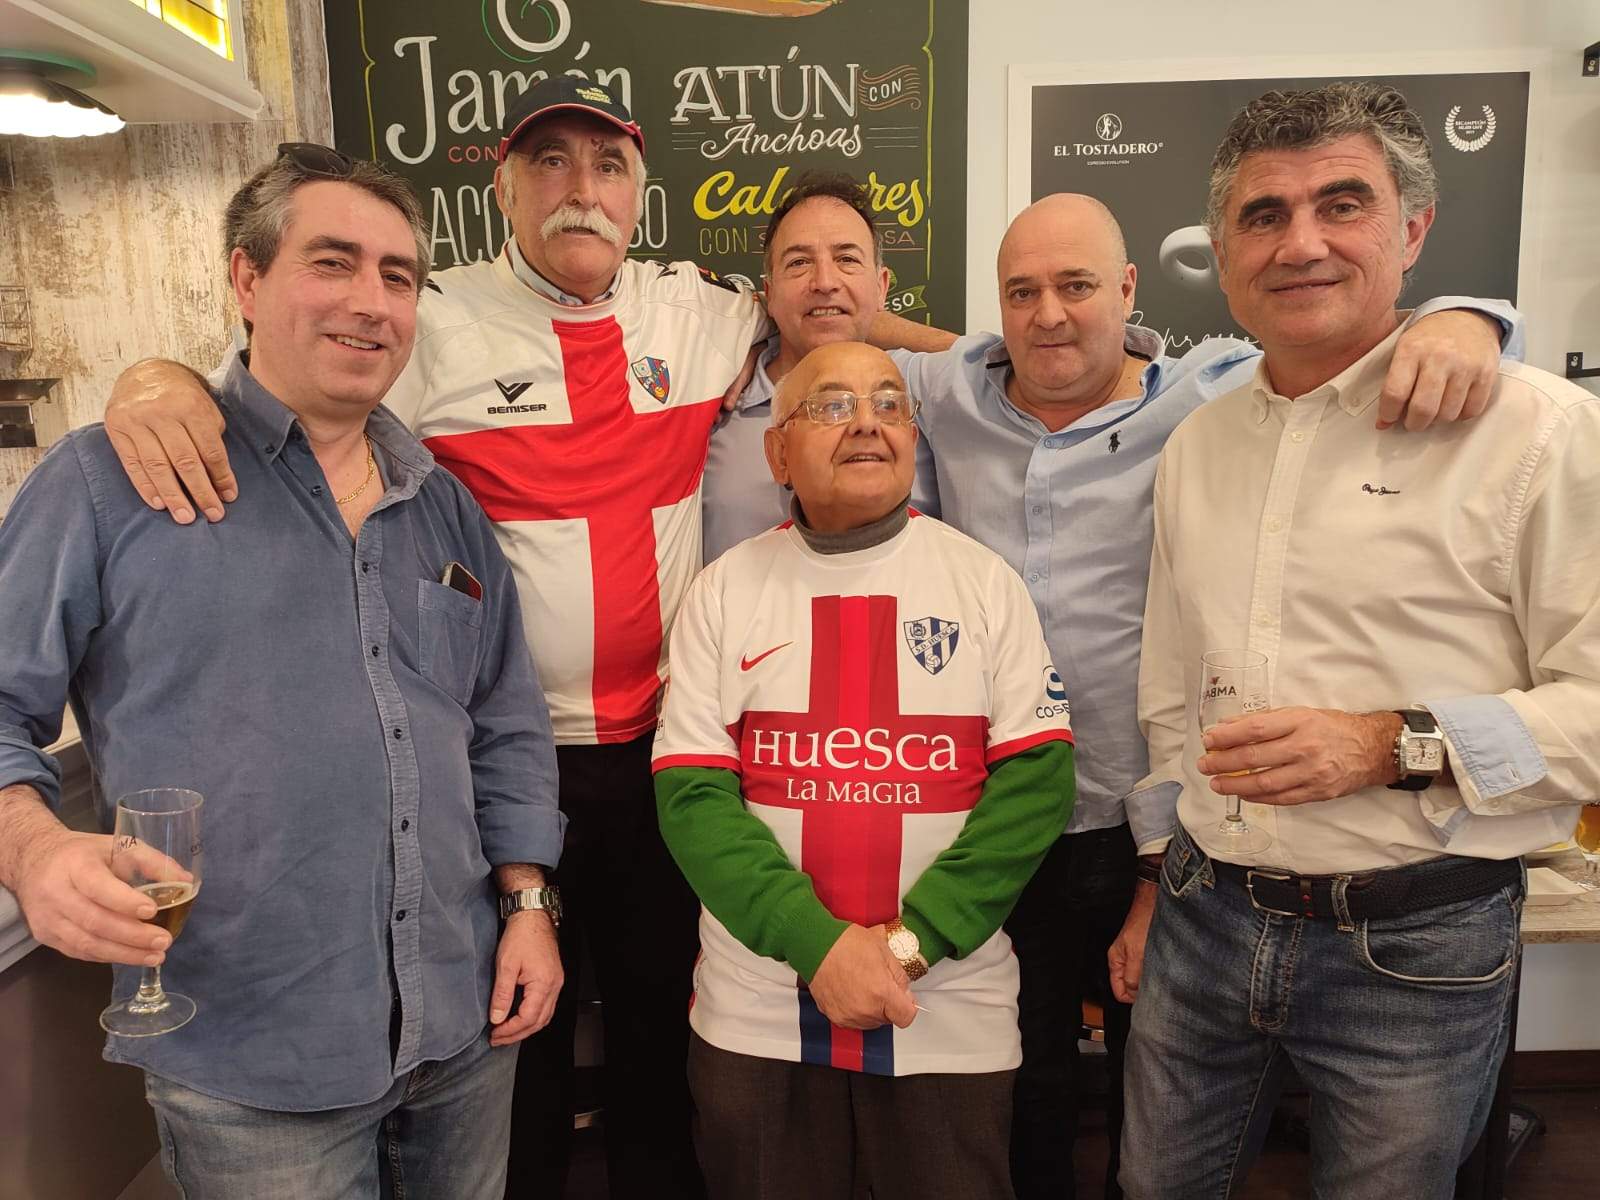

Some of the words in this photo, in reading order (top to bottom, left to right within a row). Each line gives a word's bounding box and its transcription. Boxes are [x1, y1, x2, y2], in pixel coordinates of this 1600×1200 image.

[669, 45, 860, 123] ATÚN
[869, 77, 902, 102] CON
[700, 122, 862, 159] Anchoas
[1054, 145, 1070, 157] EL
[448, 145, 499, 162] CON
[699, 227, 748, 256] CON
[487, 404, 547, 415] BEMISER
[752, 726, 960, 772] Huesca
[786, 777, 817, 801] La
